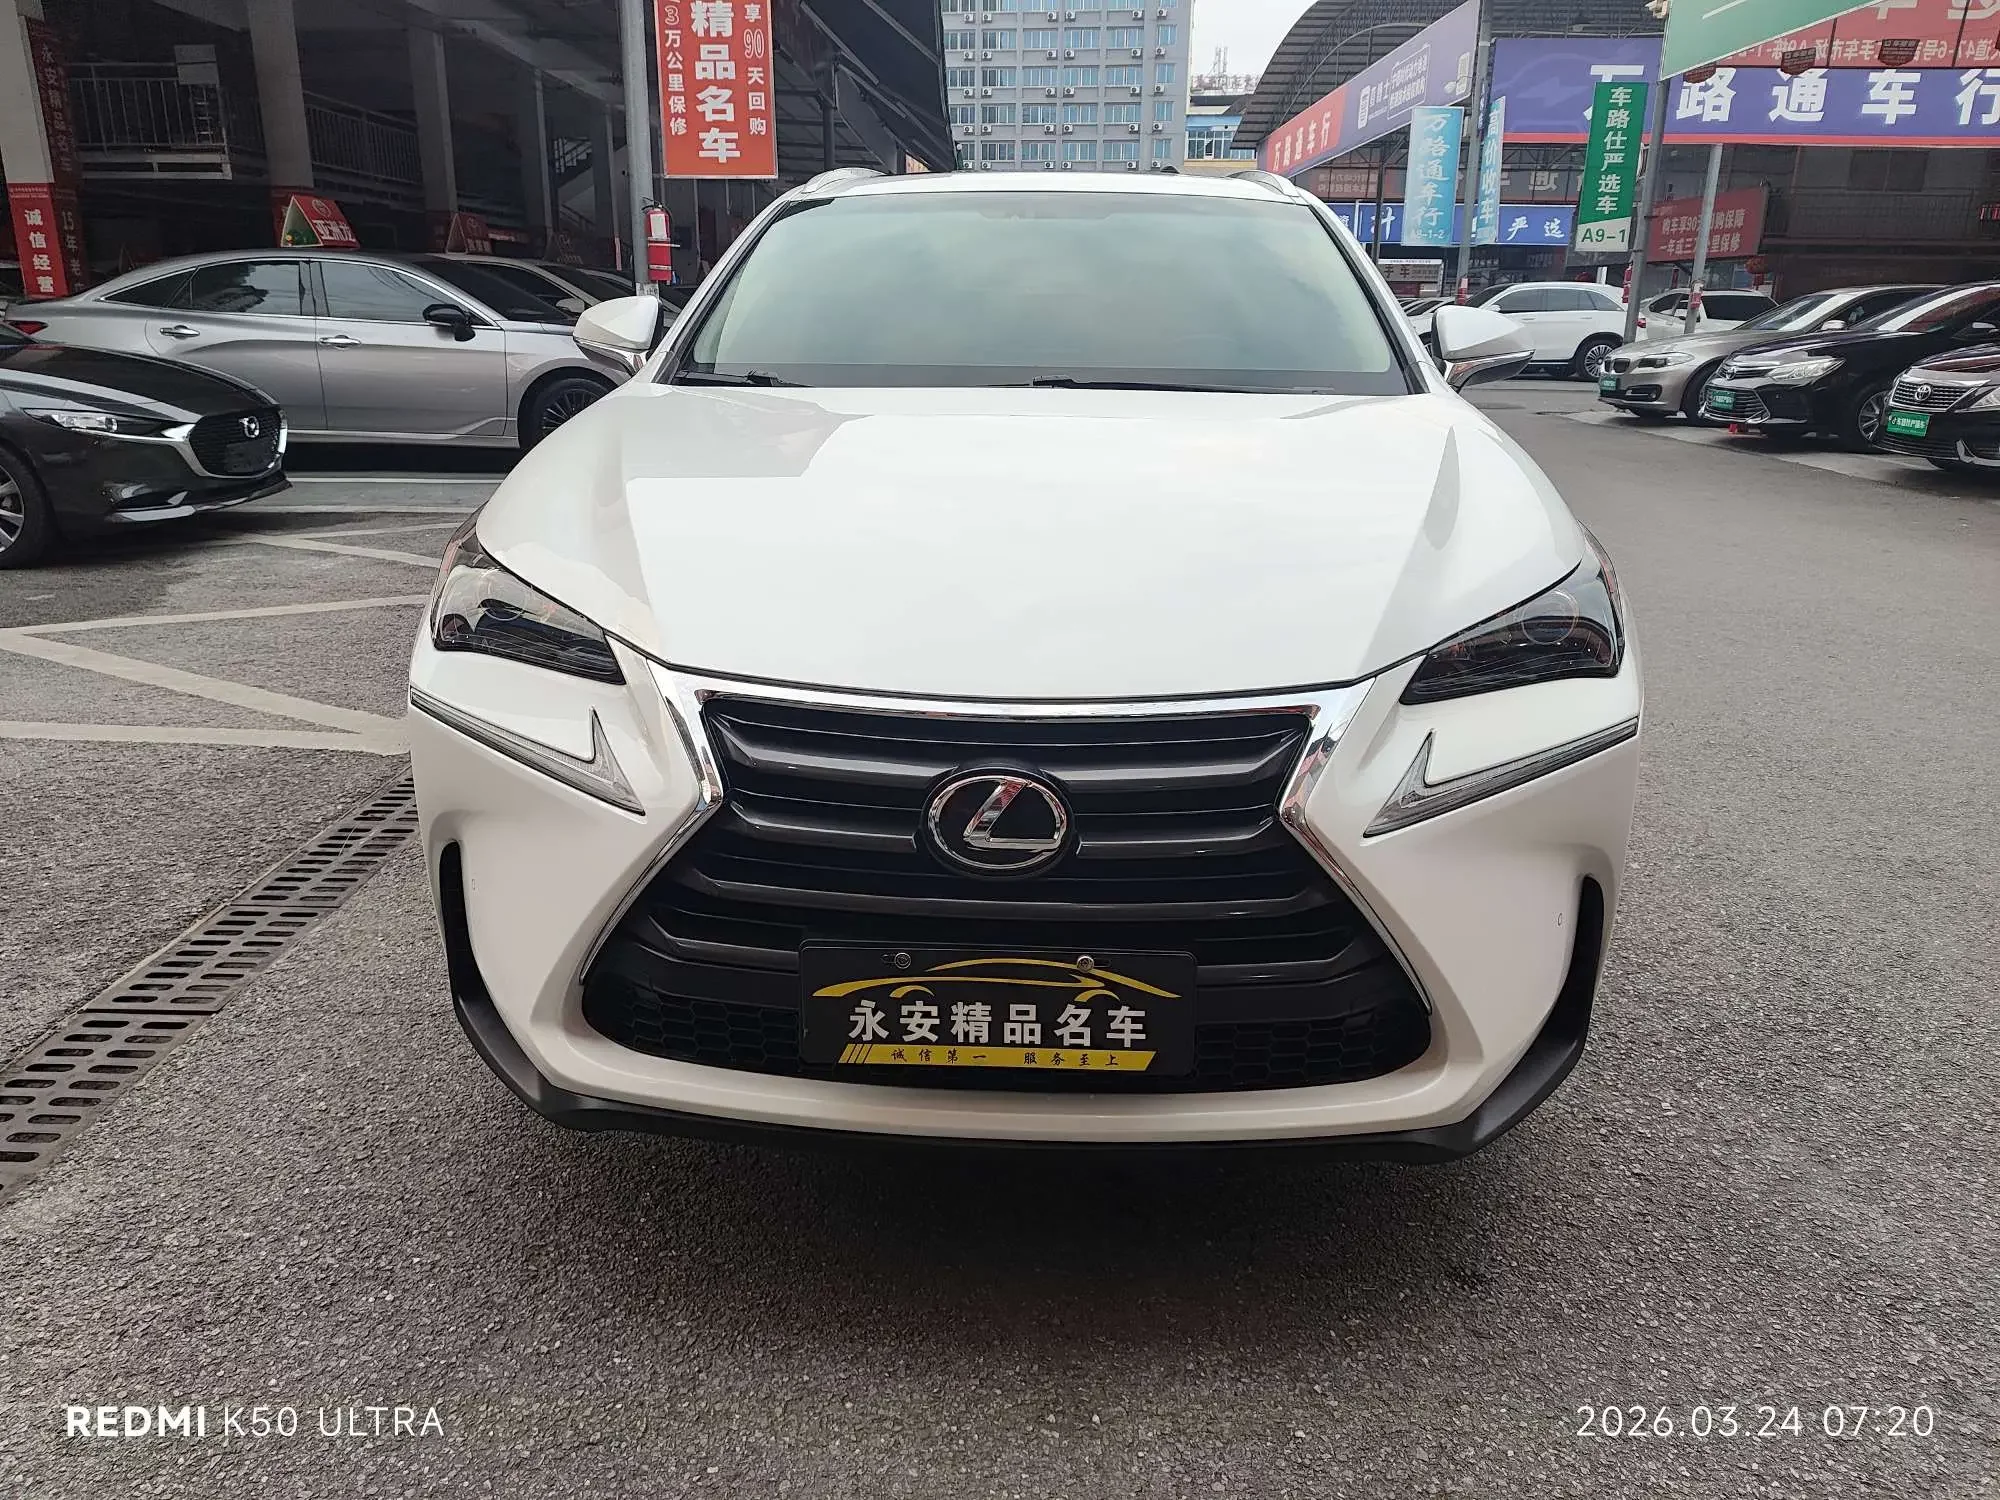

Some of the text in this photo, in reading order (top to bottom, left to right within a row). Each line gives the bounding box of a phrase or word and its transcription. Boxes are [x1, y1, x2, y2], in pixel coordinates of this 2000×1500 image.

[664, 0, 687, 136] 3万公里保修
[690, 0, 741, 164] 精品名车
[744, 3, 767, 136] 享90天回购
[1595, 86, 1633, 214] 车路仕严选车
[24, 208, 54, 293] 诚信经营
[1581, 228, 1626, 243] A9-1
[1659, 233, 1741, 256] 一年或三里保修
[1662, 208, 1746, 235] 购车享90购保障
[849, 1000, 1146, 1048] 永安精品名车
[890, 1048, 1120, 1067] 诚信第一 服务至上
